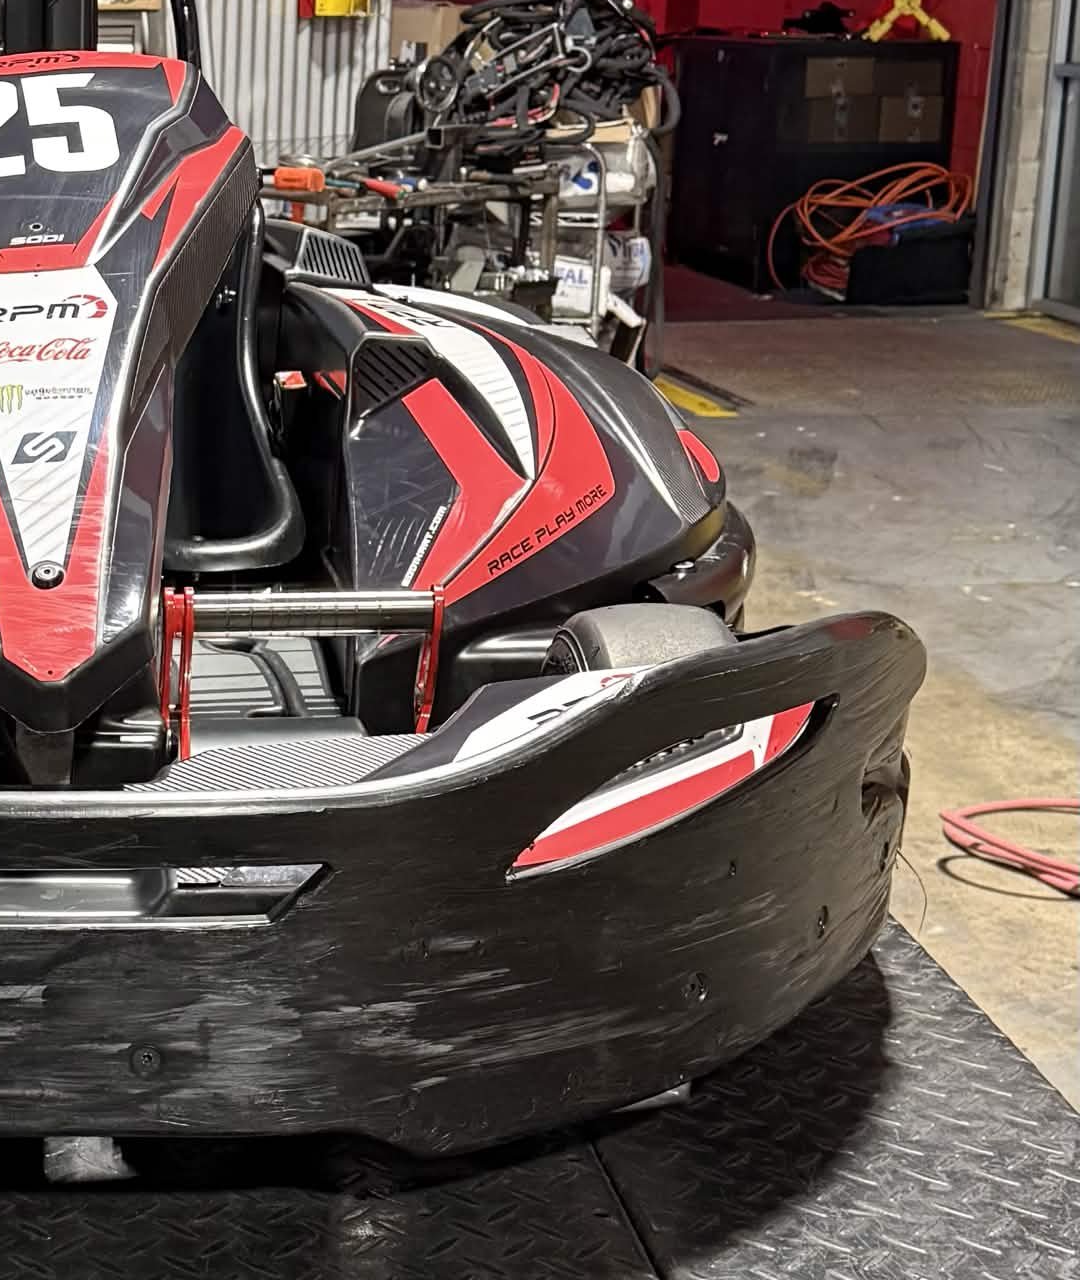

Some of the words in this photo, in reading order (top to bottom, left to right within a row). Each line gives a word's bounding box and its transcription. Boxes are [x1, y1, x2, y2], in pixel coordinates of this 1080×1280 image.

[10, 234, 65, 246] SODI
[487, 536, 534, 575] RACE
[535, 506, 576, 543] PLAY
[575, 483, 608, 515] MORE
